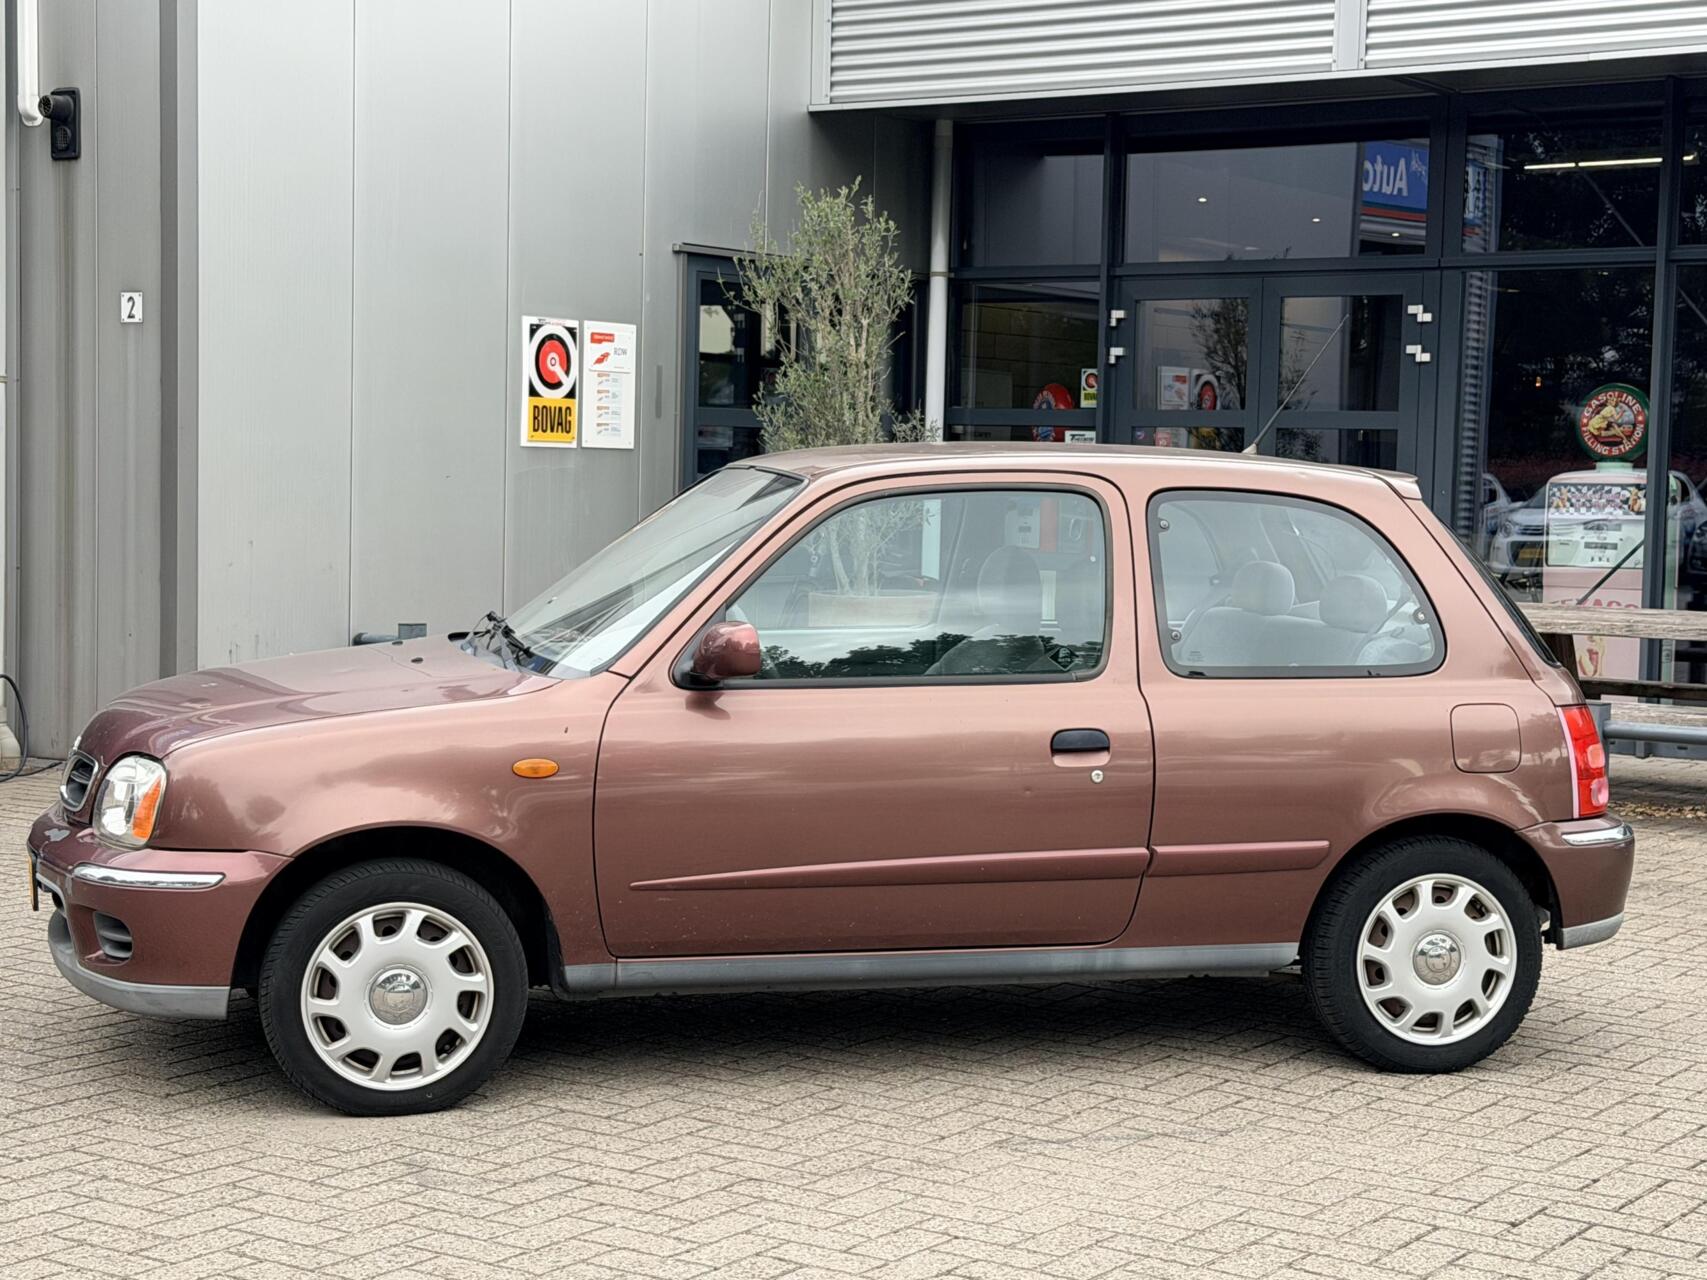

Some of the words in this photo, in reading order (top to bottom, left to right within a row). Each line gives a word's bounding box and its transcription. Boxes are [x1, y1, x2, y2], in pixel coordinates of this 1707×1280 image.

[127, 295, 136, 319] 2
[1584, 391, 1642, 417] GASOLINE
[532, 404, 572, 434] BOVAG
[1581, 427, 1609, 455] FILLING
[1612, 423, 1645, 455] STATION
